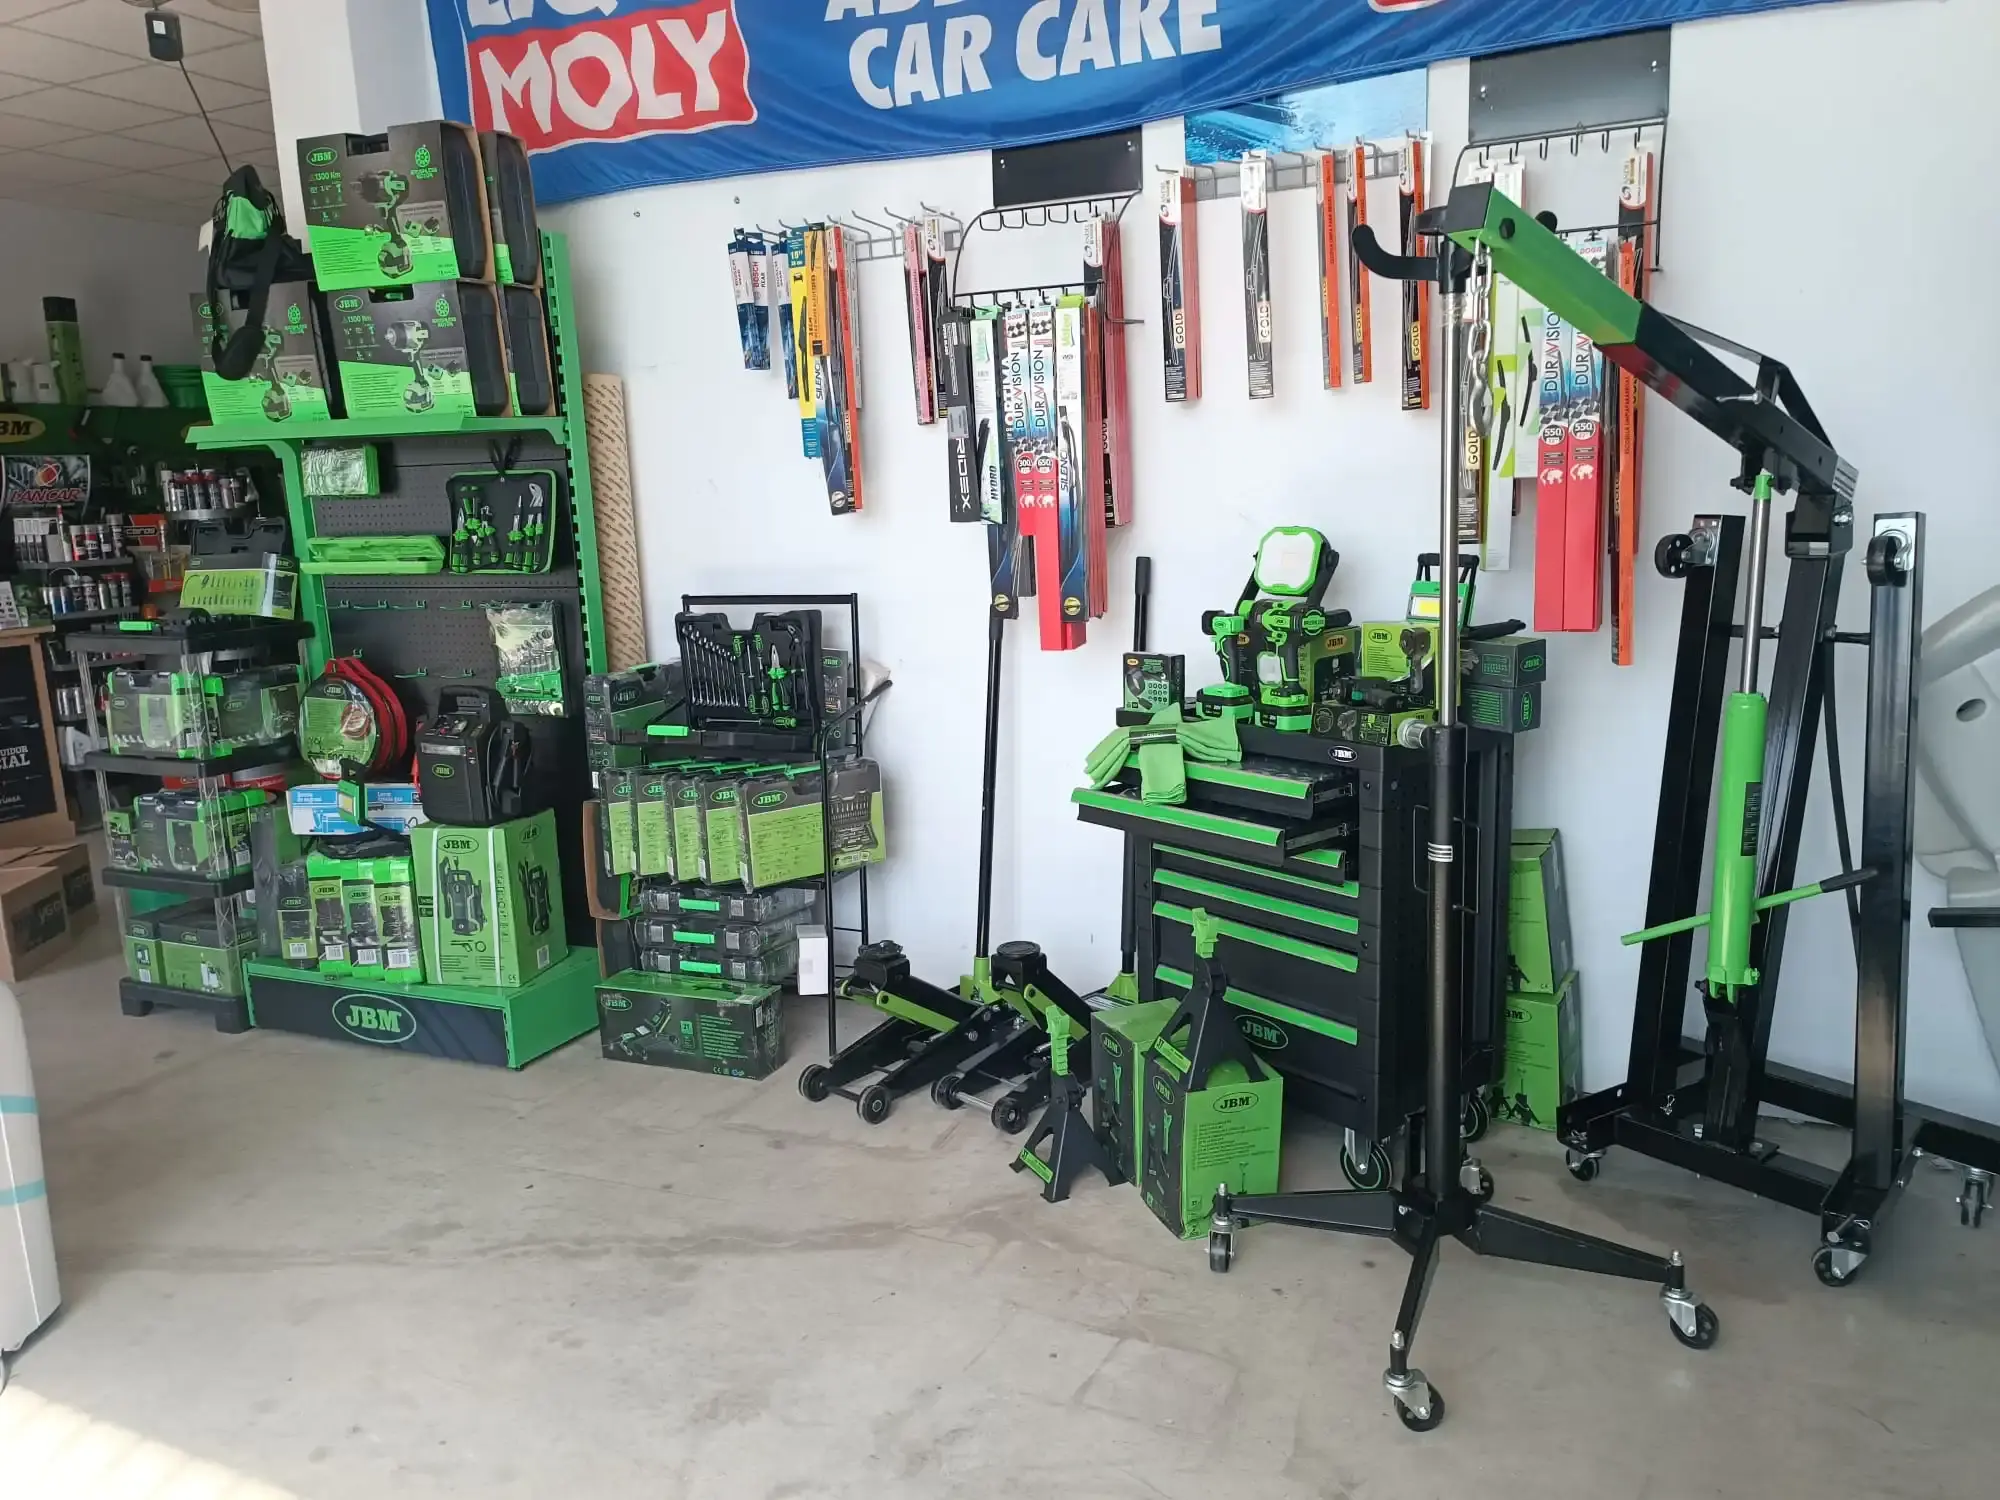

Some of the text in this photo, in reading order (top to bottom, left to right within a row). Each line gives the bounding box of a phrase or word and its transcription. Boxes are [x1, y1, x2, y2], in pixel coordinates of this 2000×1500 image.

[848, 0, 1222, 110] CAR CARE
[478, 9, 728, 134] MOLY
[311, 151, 332, 162] JBM
[752, 261, 760, 288] BOSCH
[338, 299, 359, 309] JBM
[1175, 313, 1184, 344] GOLD
[1260, 305, 1269, 338] GOLD
[1412, 326, 1420, 357] GOLD
[1544, 312, 1560, 392] DURAVISIO
[1010, 352, 1025, 429] DURAVISION
[1033, 350, 1046, 428] DURAVISION
[1544, 428, 1561, 437] 550
[1575, 422, 1591, 431] 550
[1468, 430, 1479, 465] GOLD
[1018, 459, 1031, 468] 300
[1037, 459, 1051, 468] 650
[956, 438, 971, 509] RIDEX
[989, 465, 998, 501] HYDRO
[11, 488, 81, 503] LANCAR
[1327, 637, 1344, 648] JBM
[1372, 632, 1388, 641] JBM
[1524, 657, 1540, 670] JBM
[1523, 697, 1531, 722] JBM
[1332, 749, 1354, 759] JBM
[759, 793, 782, 805] JBM
[444, 839, 471, 849] JBM
[345, 1004, 402, 1033] JBM
[1505, 1010, 1525, 1021] BM
[1242, 1020, 1281, 1044] JBM
[1103, 1036, 1119, 1054] JBM
[1155, 1080, 1171, 1100] JBM
[1220, 1094, 1252, 1109] JBM
